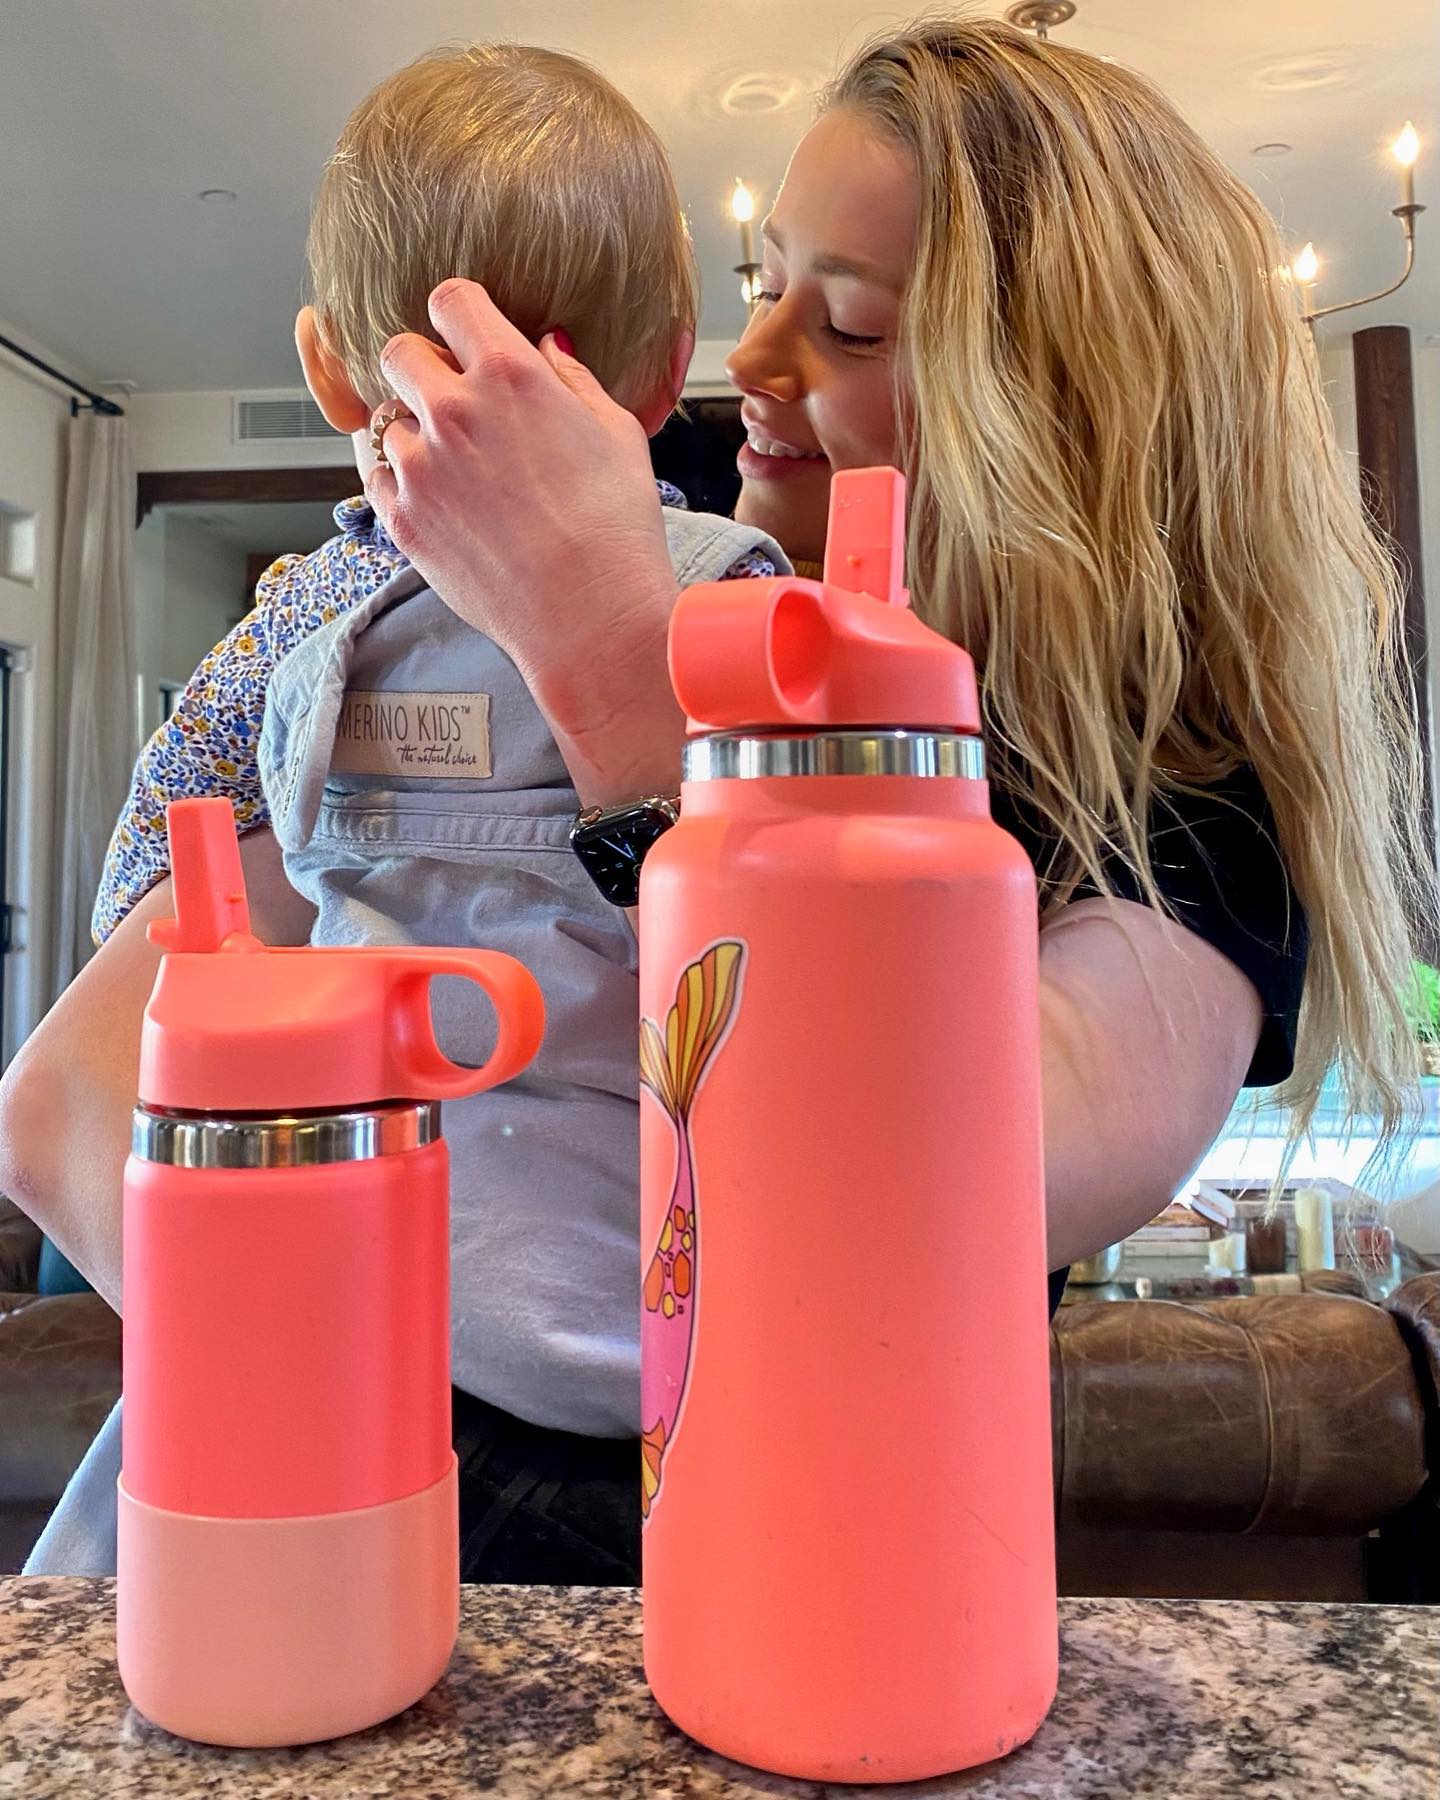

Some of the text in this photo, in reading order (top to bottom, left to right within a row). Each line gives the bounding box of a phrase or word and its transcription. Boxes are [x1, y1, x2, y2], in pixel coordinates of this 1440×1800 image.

[337, 703, 408, 741] MERINO
[396, 743, 477, 765] the natural choice
